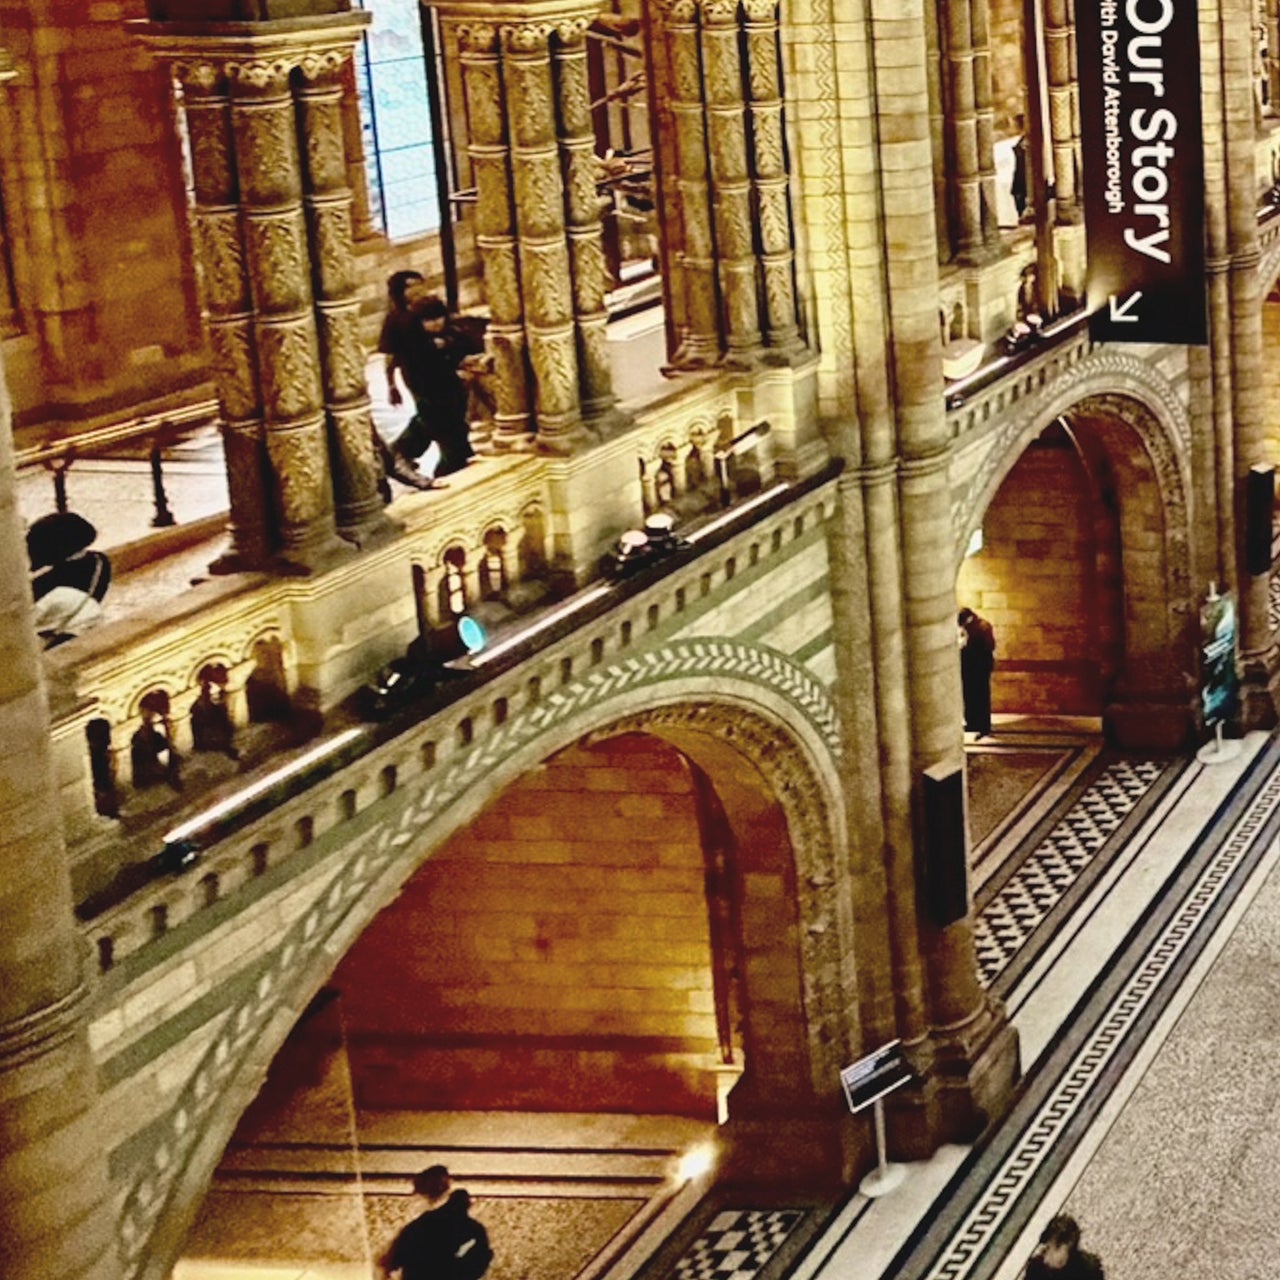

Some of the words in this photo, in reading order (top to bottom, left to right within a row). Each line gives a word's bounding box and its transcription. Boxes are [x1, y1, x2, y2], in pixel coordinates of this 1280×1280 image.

[1101, 29, 1121, 84] David
[1103, 85, 1126, 214] Attenborough
[1123, 108, 1178, 264] Story
